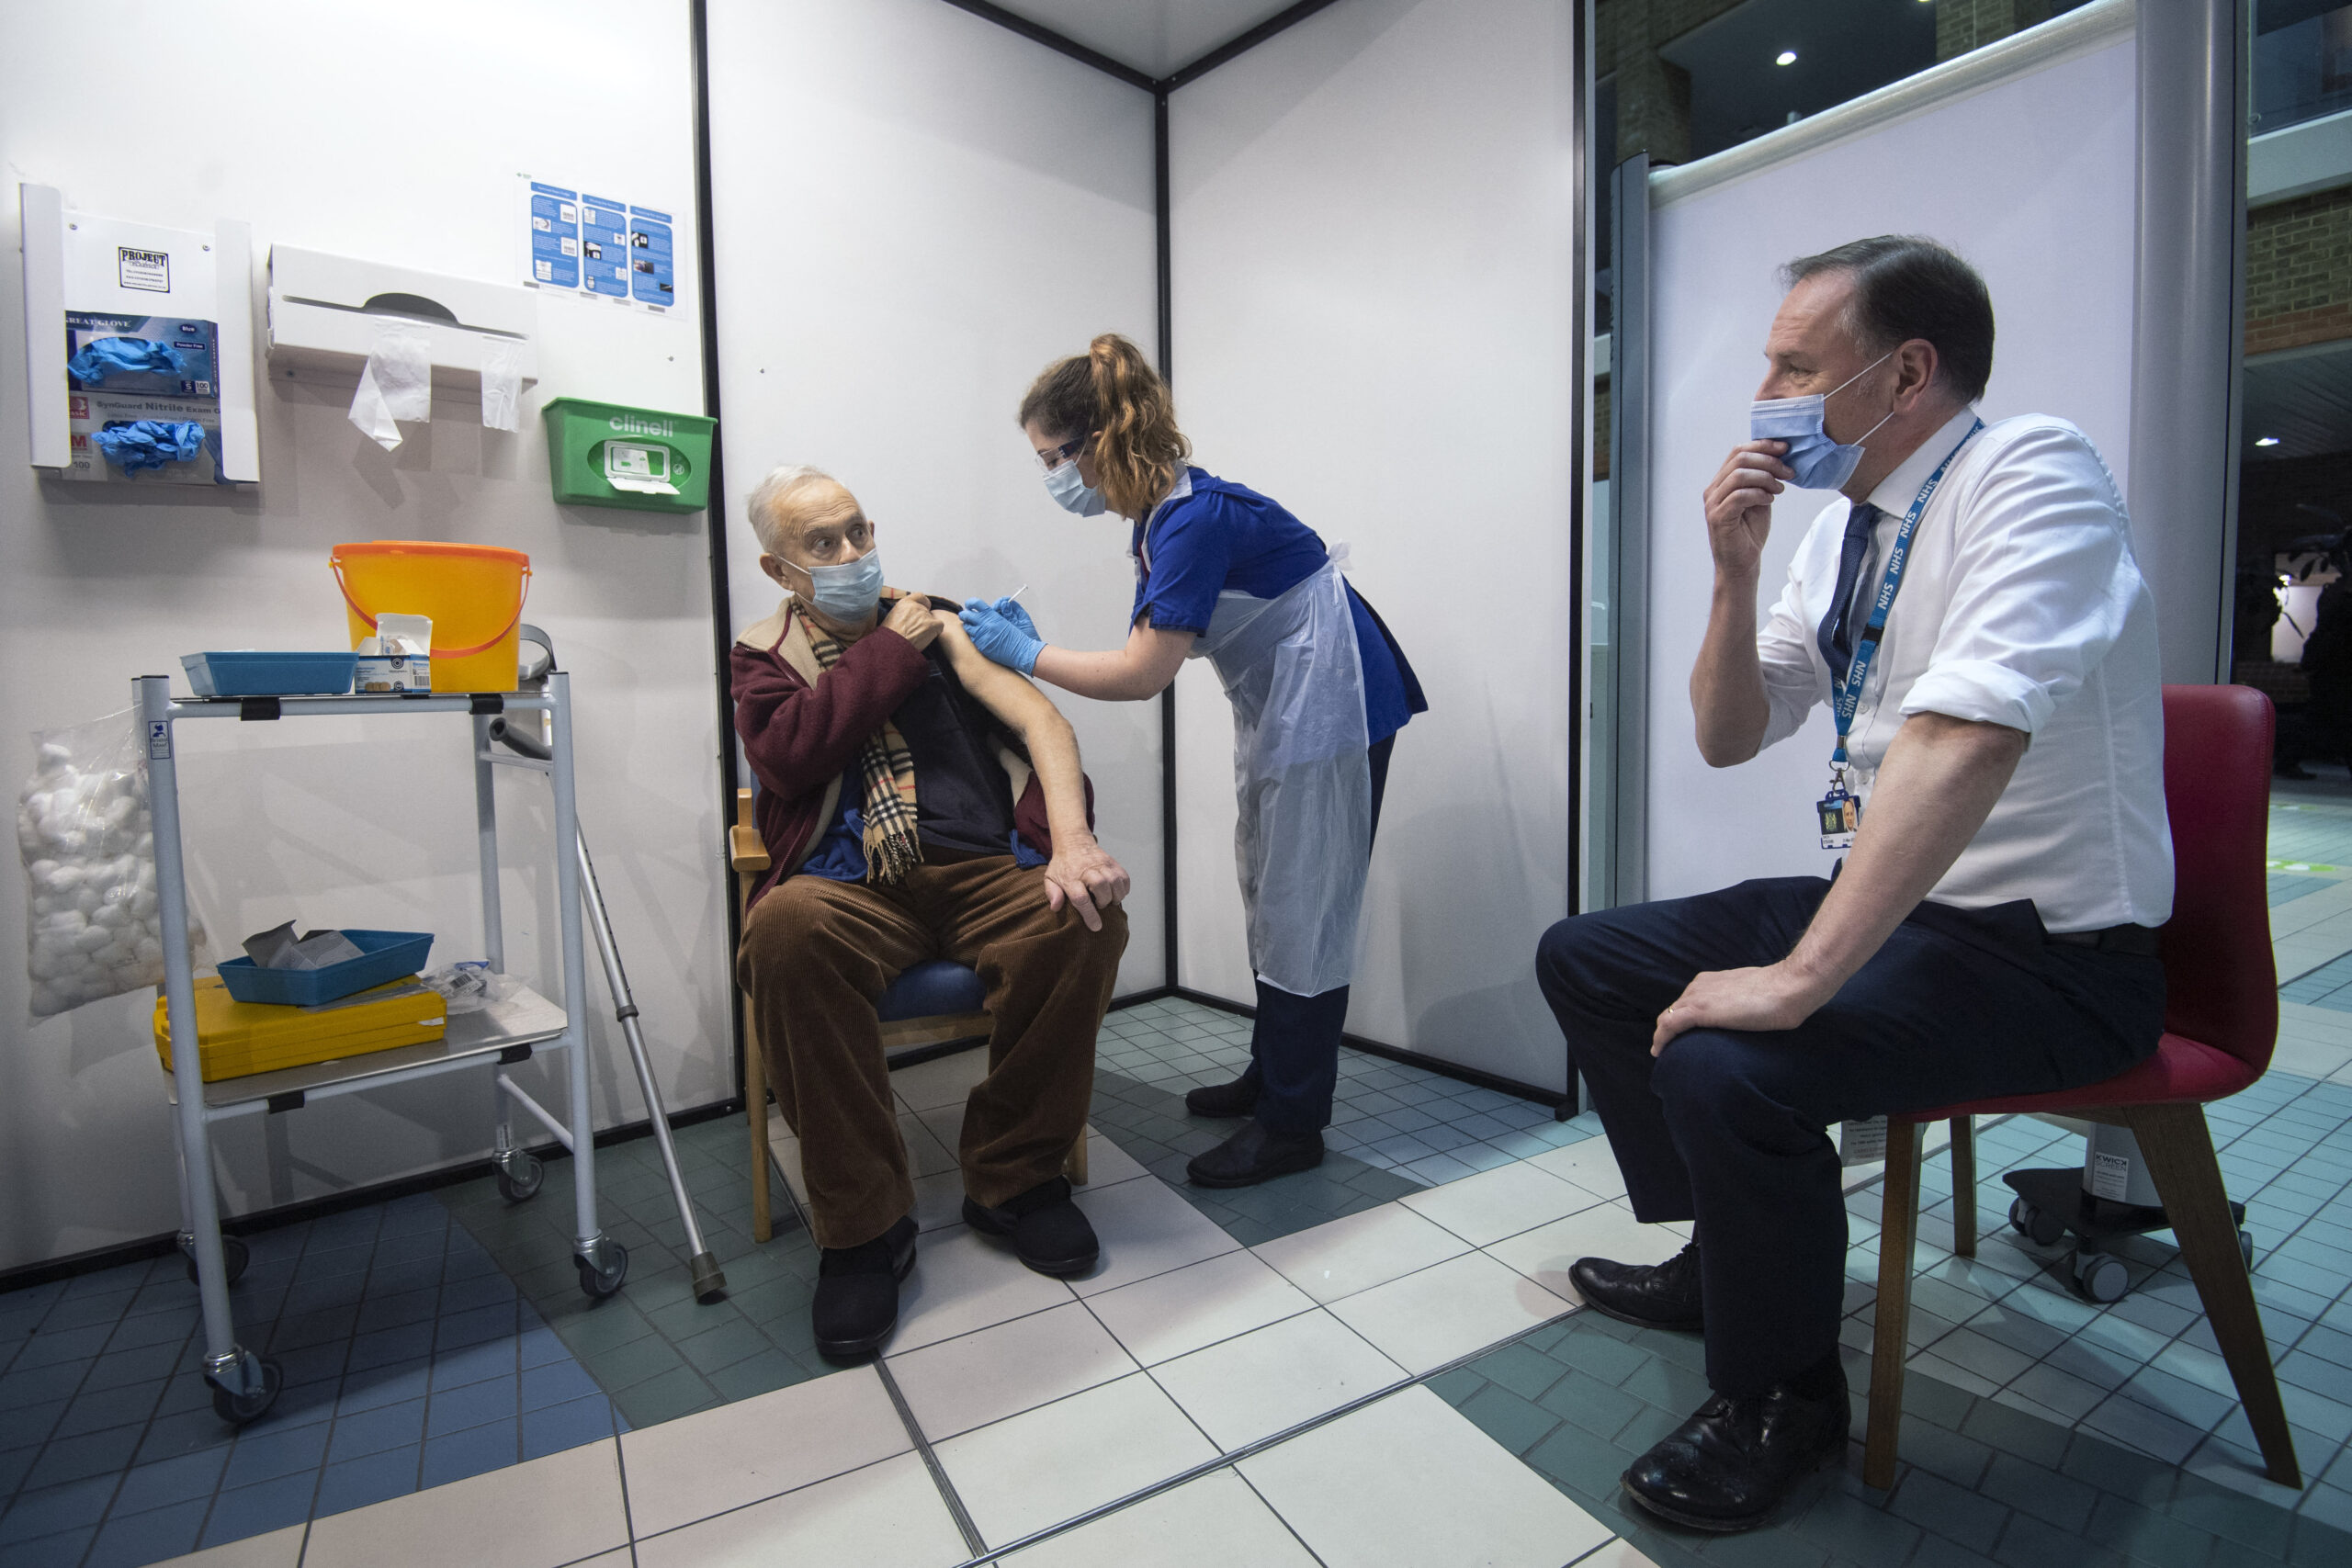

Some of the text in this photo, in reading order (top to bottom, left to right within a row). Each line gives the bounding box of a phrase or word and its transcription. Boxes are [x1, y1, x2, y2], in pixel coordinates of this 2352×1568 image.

[121, 249, 166, 267] PROJECT
[96, 320, 132, 328] GLOVE
[96, 400, 142, 410] SynGuard
[145, 402, 184, 412] Nitrile
[186, 406, 212, 414] Exam
[609, 414, 673, 438] clinell
[74, 461, 91, 469] 100
[1917, 479, 1939, 503] NHS
[1900, 511, 1917, 538] NHS
[1889, 547, 1904, 575] NHS
[1877, 582, 1894, 610] NHS
[1851, 660, 1867, 687] NHS
[1841, 694, 1857, 719] NHS
[2096, 1154, 2127, 1167] KWICK
